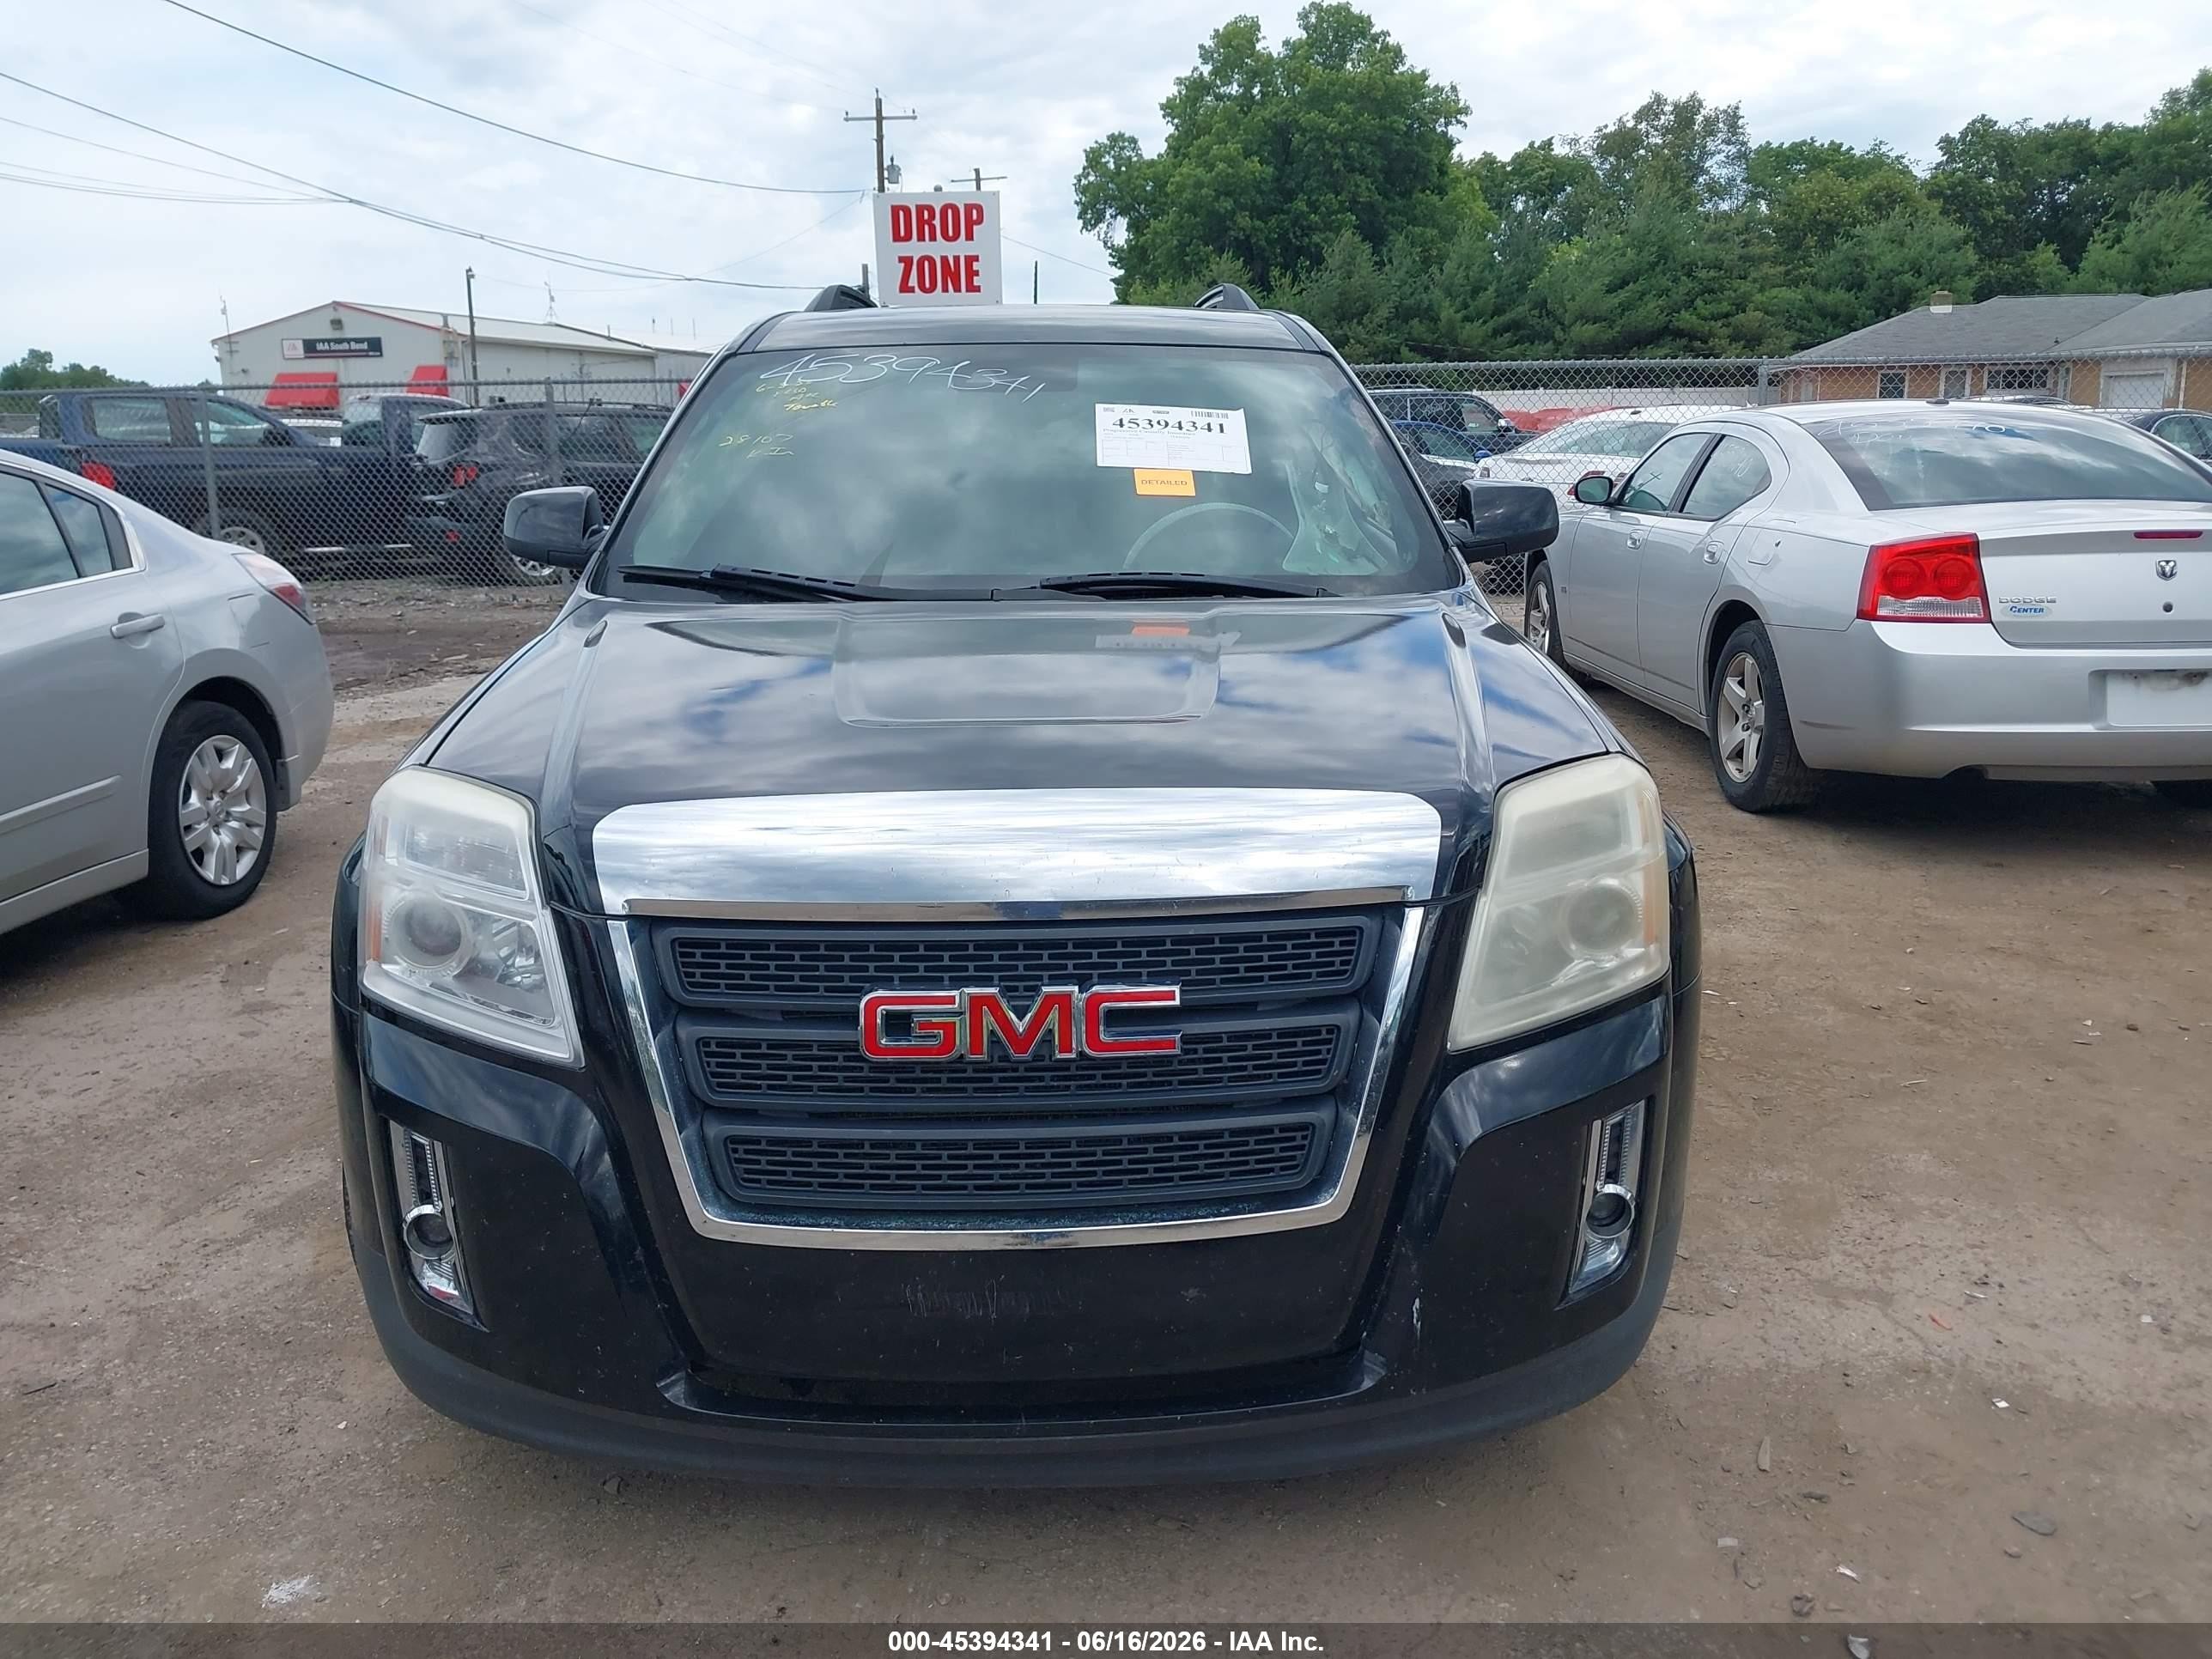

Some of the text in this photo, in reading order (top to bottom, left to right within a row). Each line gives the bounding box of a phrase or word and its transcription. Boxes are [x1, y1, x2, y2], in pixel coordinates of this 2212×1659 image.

[890, 203, 985, 242] DROP
[897, 254, 981, 294] ZONE
[760, 353, 1046, 404] 45394341
[1112, 417, 1227, 434] 45394341
[2009, 605, 2045, 614] CENTER
[859, 984, 1182, 1062] GMC
